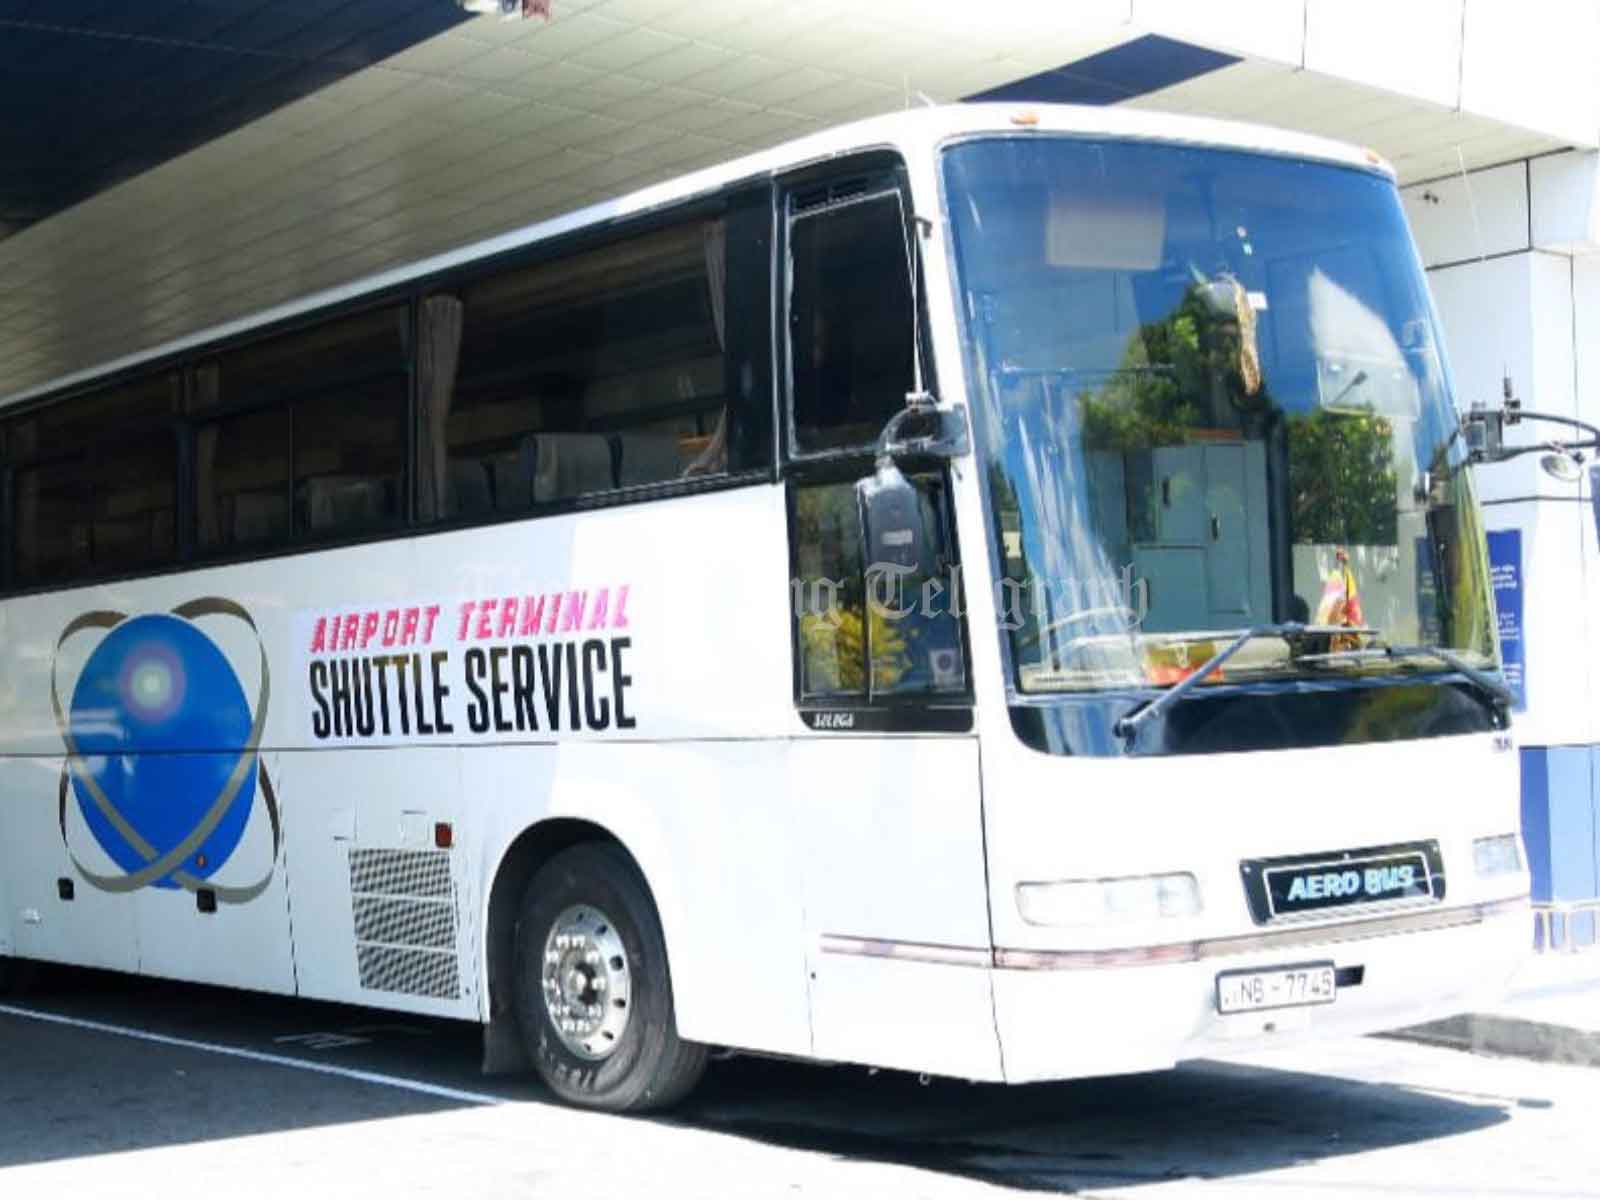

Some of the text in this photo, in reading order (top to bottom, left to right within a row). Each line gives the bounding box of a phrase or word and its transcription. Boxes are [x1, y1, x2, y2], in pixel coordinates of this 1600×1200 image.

[310, 586, 631, 653] AIRPORT TERMINAL
[309, 636, 636, 740] SHUTTLE SERVICE
[1287, 864, 1416, 901] AERO BUS
